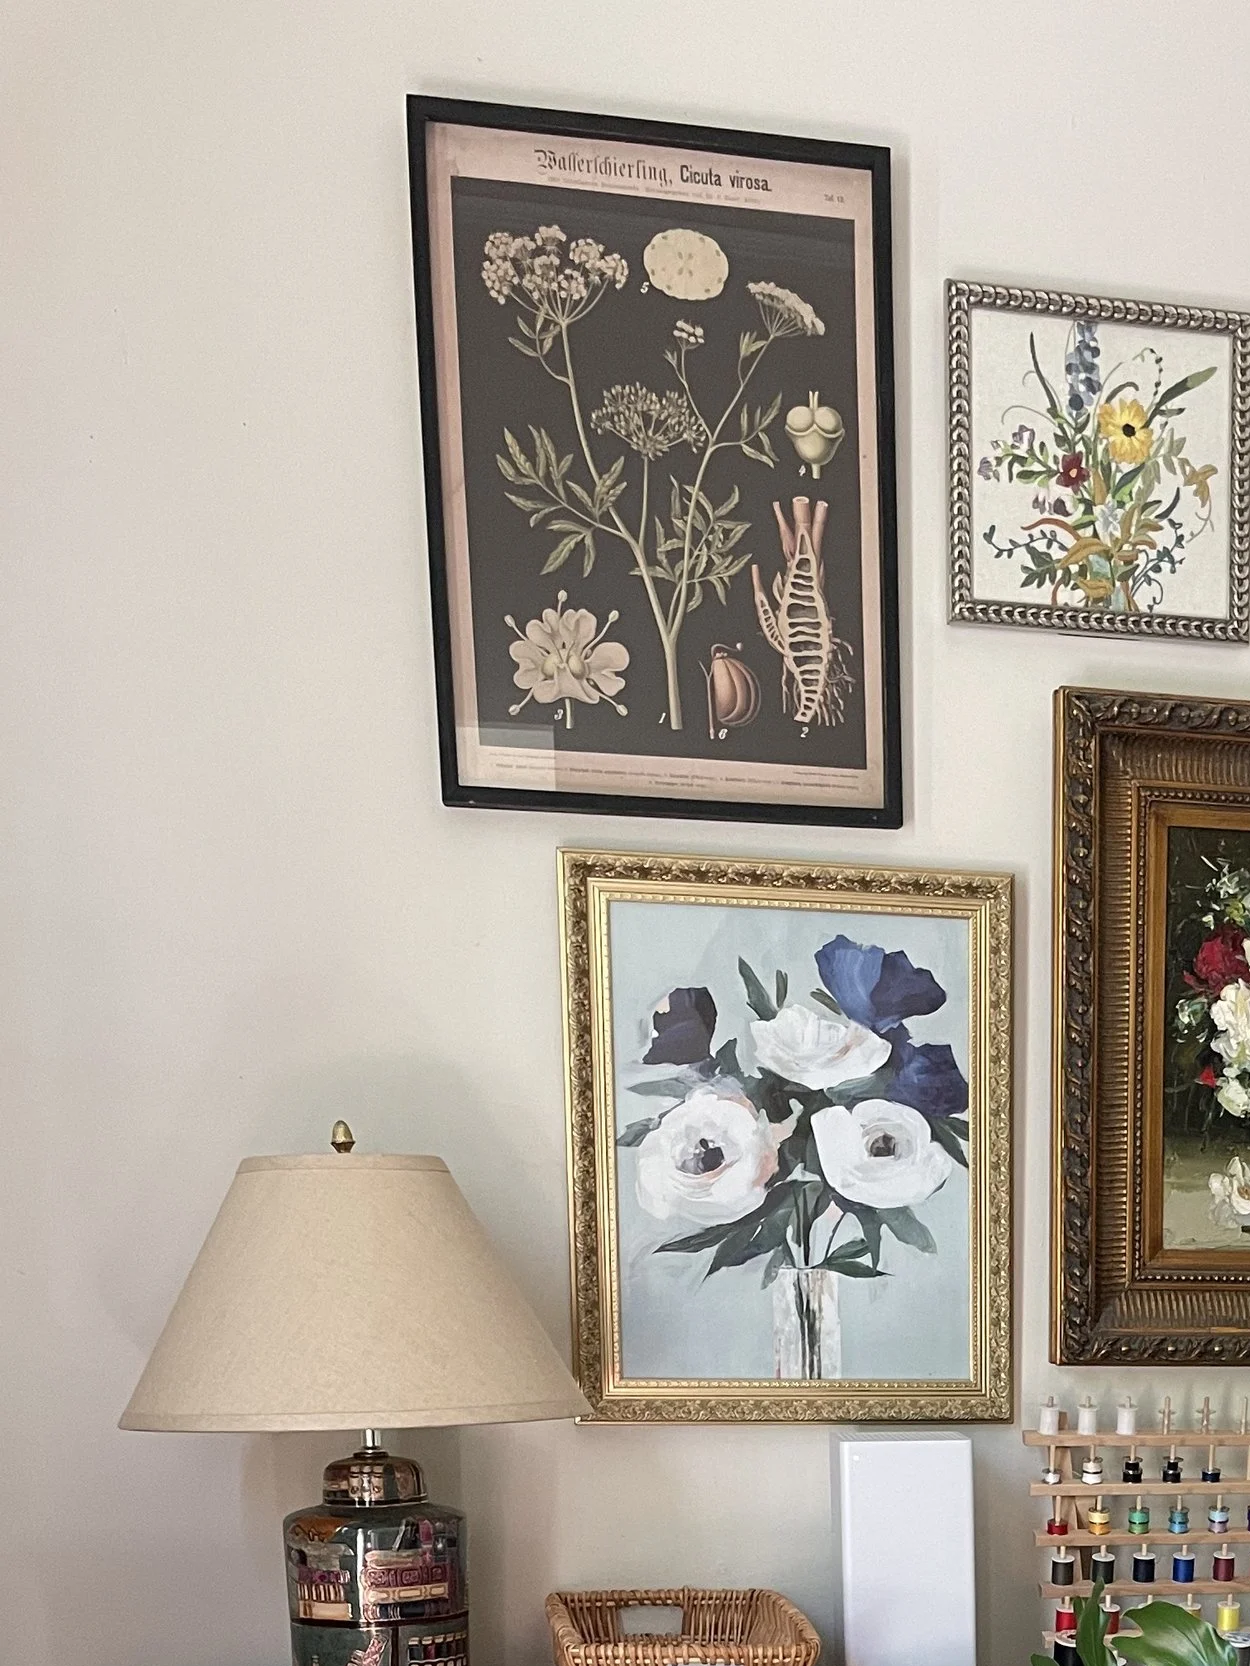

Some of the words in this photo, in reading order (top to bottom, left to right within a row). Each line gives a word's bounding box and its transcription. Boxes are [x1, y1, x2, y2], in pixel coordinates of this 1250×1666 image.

[680, 164, 722, 187] Cicuta
[640, 281, 650, 294] 5
[553, 709, 564, 720] 3
[658, 712, 667, 723] 1
[800, 727, 810, 739] 2
